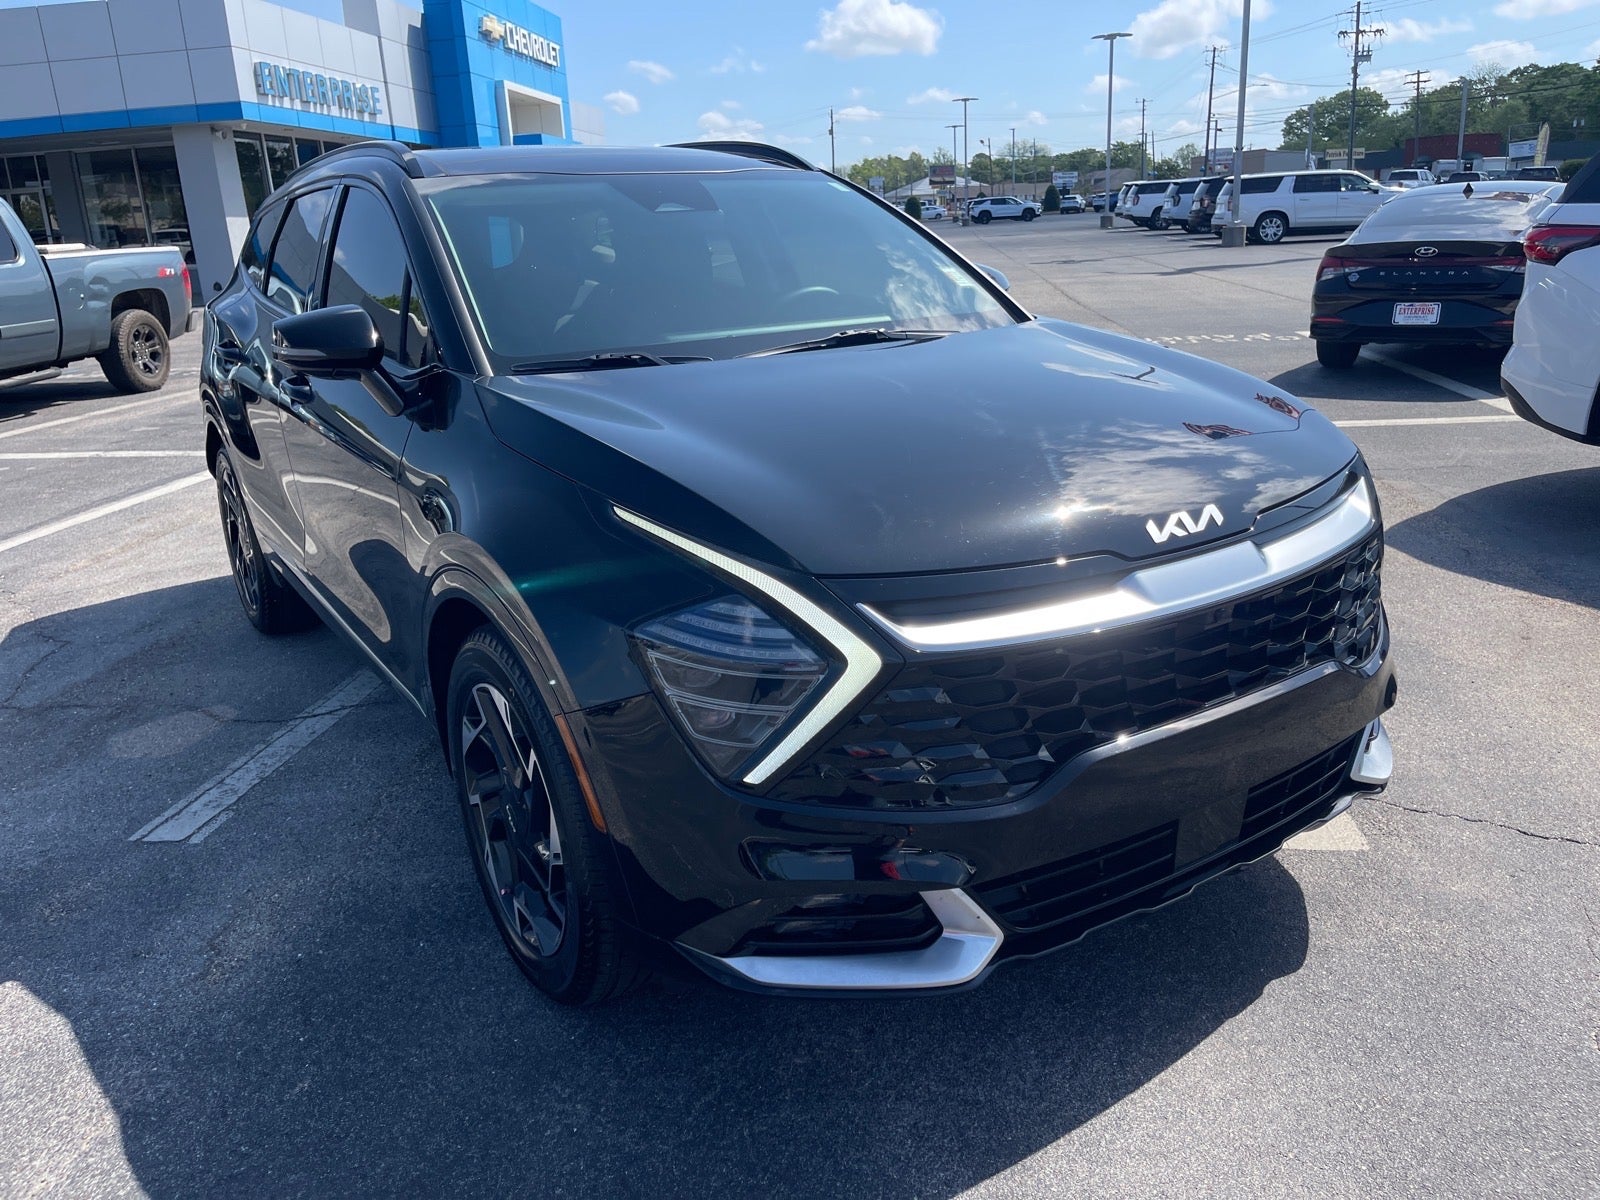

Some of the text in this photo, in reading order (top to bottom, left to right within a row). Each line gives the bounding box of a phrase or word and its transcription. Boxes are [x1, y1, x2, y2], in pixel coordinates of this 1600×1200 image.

[503, 21, 561, 68] CHEVROLET
[254, 61, 382, 115] ENTERPRISE
[1398, 307, 1436, 316] ENTERPRISE
[1145, 503, 1224, 544] KIA
